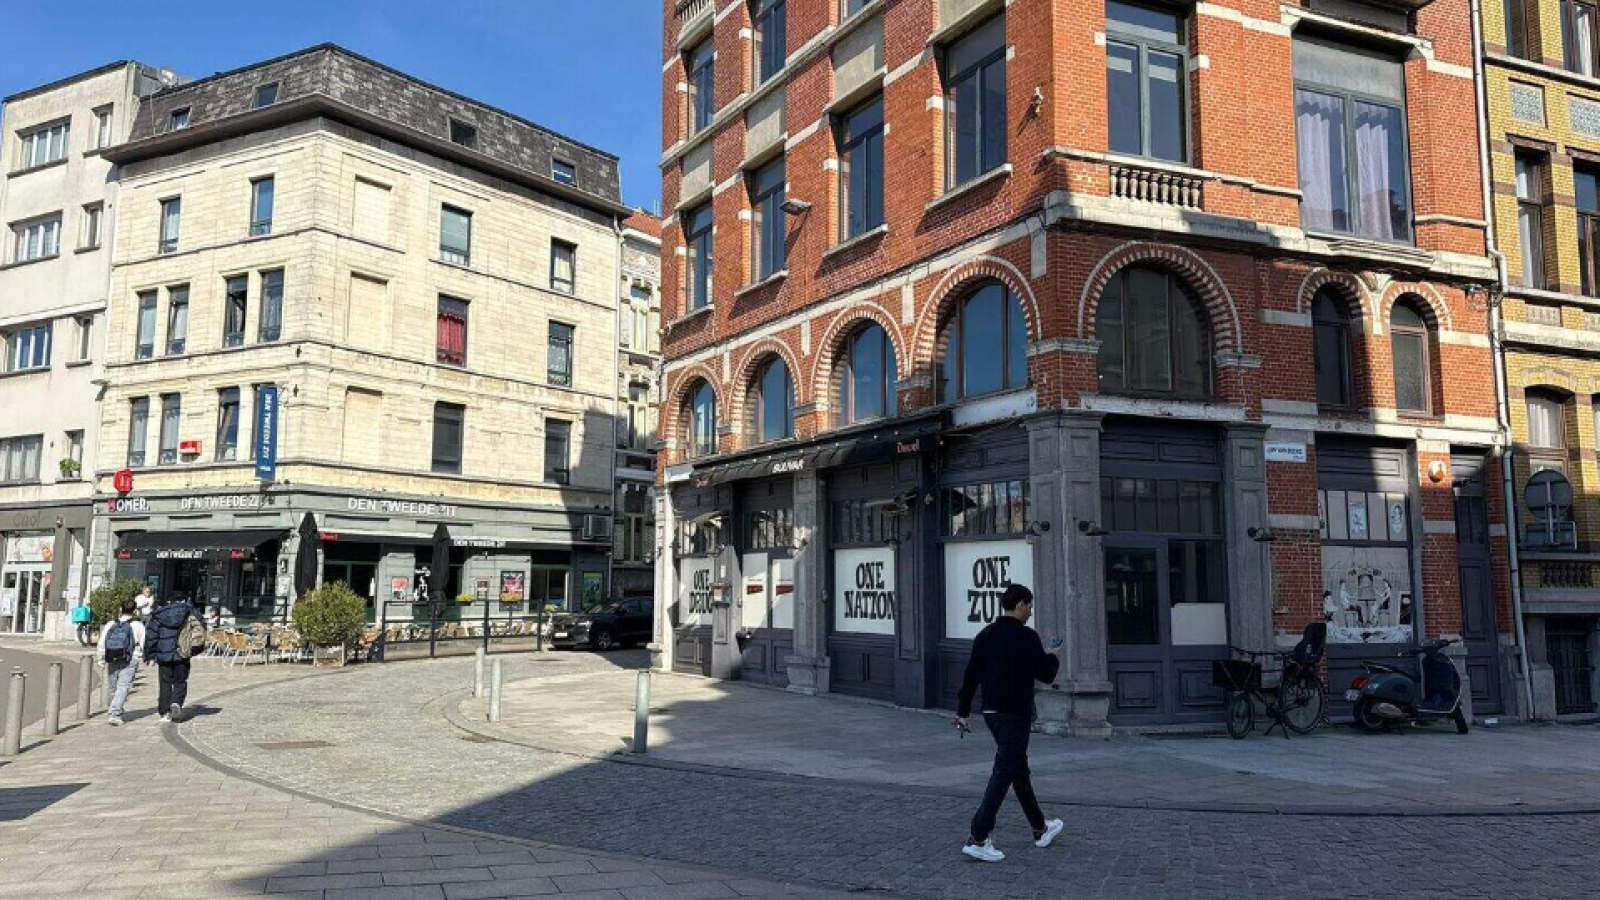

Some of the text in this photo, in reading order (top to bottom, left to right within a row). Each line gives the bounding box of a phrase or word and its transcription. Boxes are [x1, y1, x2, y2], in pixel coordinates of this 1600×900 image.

[204, 496, 247, 509] TWEEDE
[348, 497, 458, 517] DEN TWEEDE ZIT
[693, 568, 710, 590] ONE
[856, 561, 885, 590] ONE
[972, 555, 1012, 589] ONE
[844, 590, 896, 620] NATION
